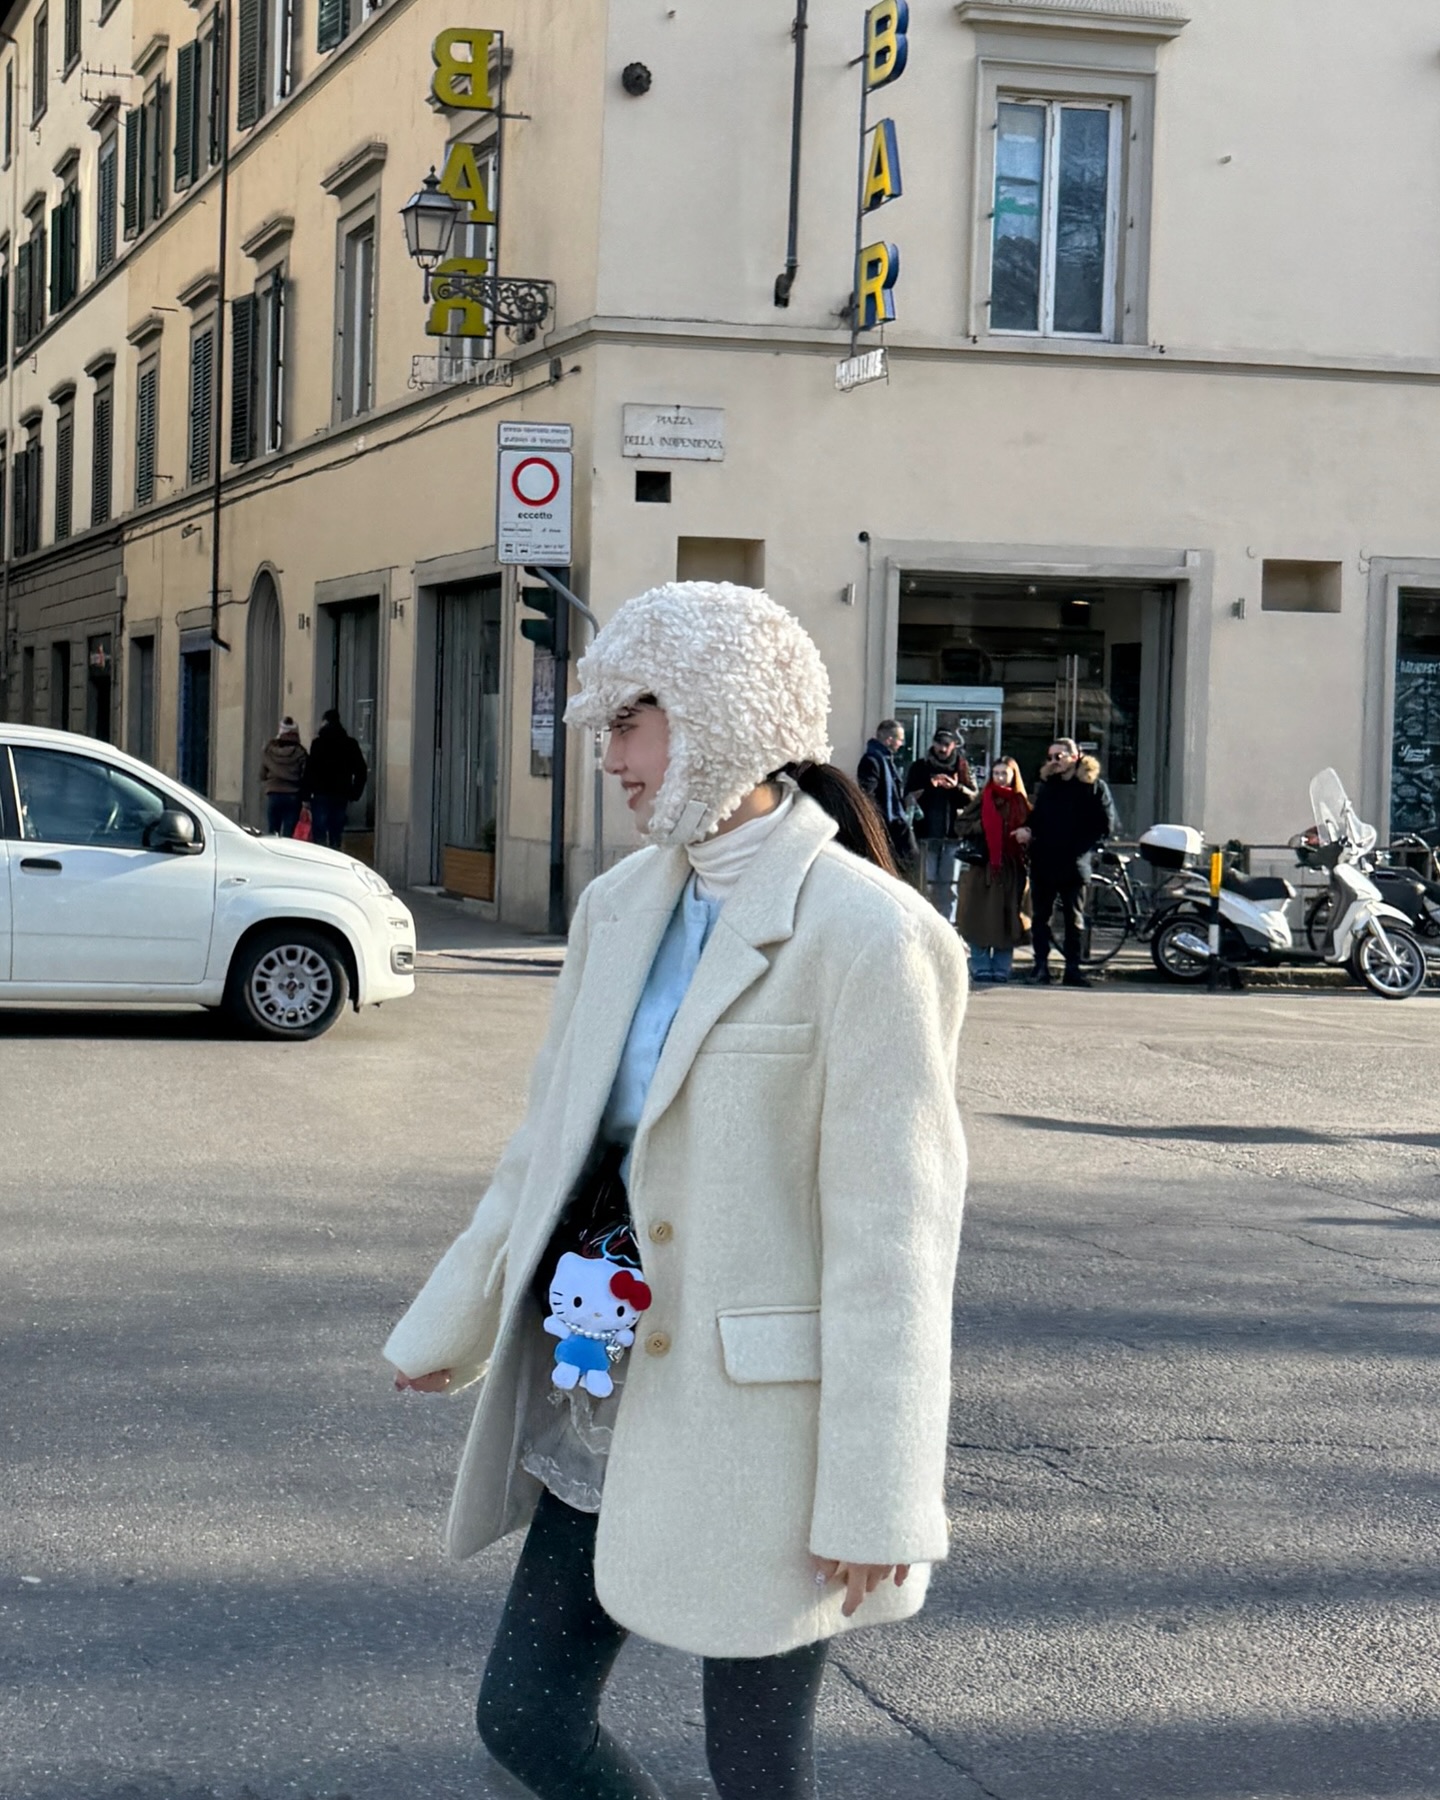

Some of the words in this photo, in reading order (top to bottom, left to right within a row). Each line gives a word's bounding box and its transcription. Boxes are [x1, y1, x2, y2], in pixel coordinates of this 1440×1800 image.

[856, 0, 910, 331] BAR
[656, 415, 693, 425] PIAZZA
[517, 511, 553, 520] eccetto
